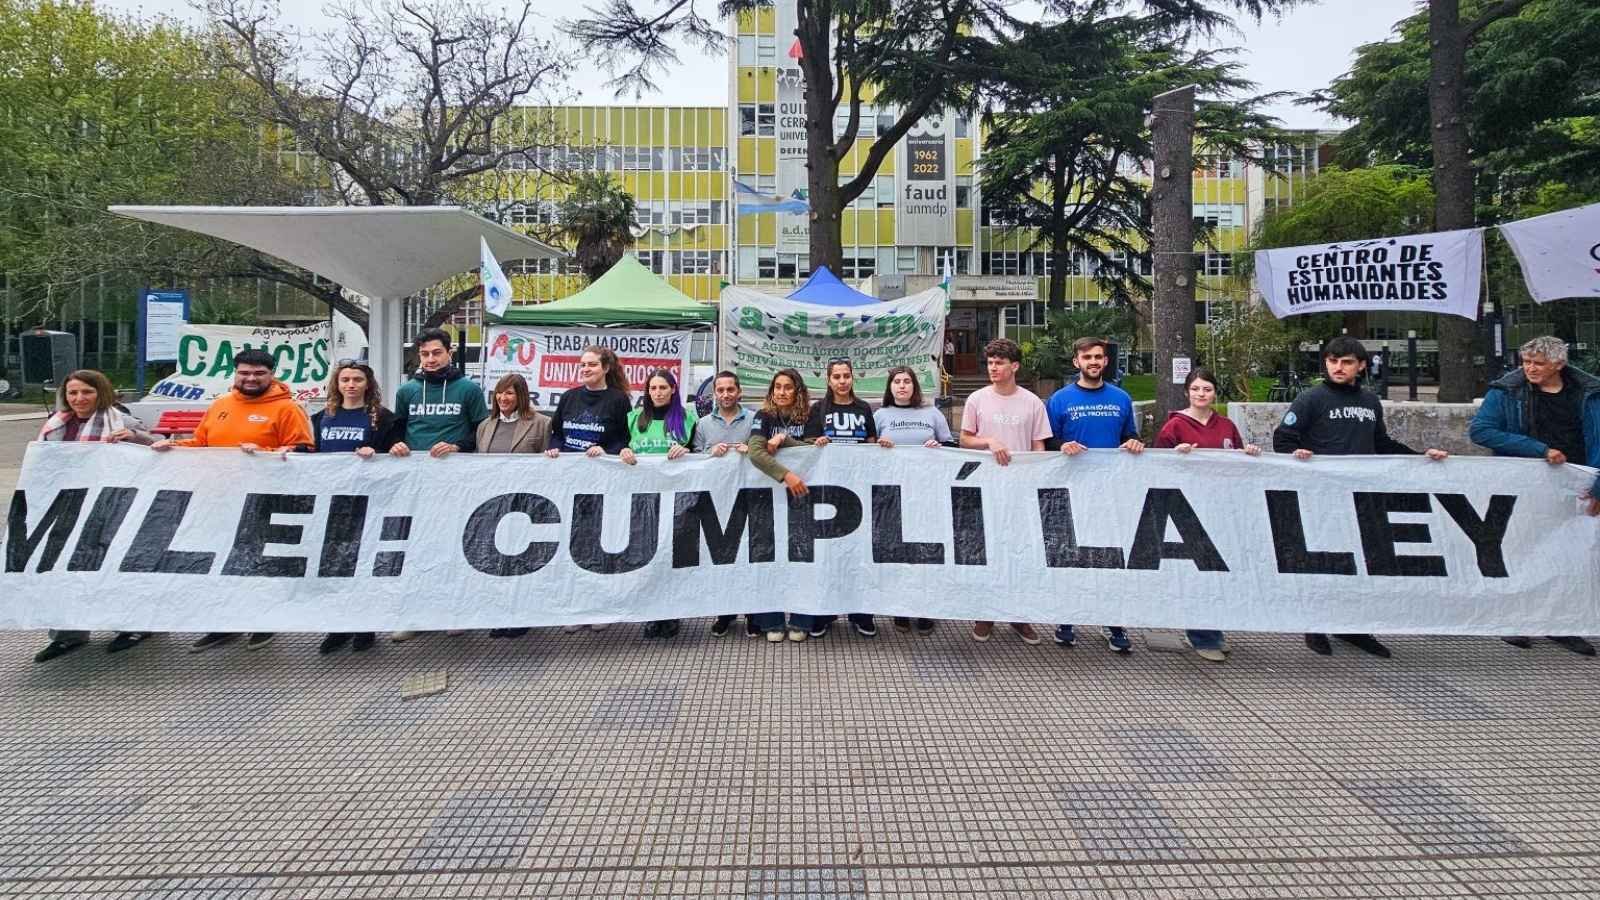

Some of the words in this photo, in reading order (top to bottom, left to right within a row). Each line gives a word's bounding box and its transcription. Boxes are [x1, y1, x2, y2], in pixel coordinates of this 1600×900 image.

[780, 117, 806, 128] CERR
[914, 150, 938, 161] 1962
[913, 163, 939, 174] 2022
[905, 184, 947, 200] faud
[906, 202, 947, 217] unmdp
[1296, 247, 1388, 270] CENTRO
[1400, 244, 1434, 262] DE
[1288, 262, 1443, 287] ESTUDIANTES
[1287, 282, 1448, 305] HUMANIDADES
[736, 352, 828, 369] UNIVERSITARI
[852, 353, 930, 370] ARPLATENSE
[154, 380, 205, 401] MNR
[408, 403, 462, 415] CAUCES
[4, 486, 413, 577] MILEI:
[462, 461, 988, 577] CUMPLÍ
[1037, 488, 1230, 572] LA
[1264, 490, 1518, 578] LEY
